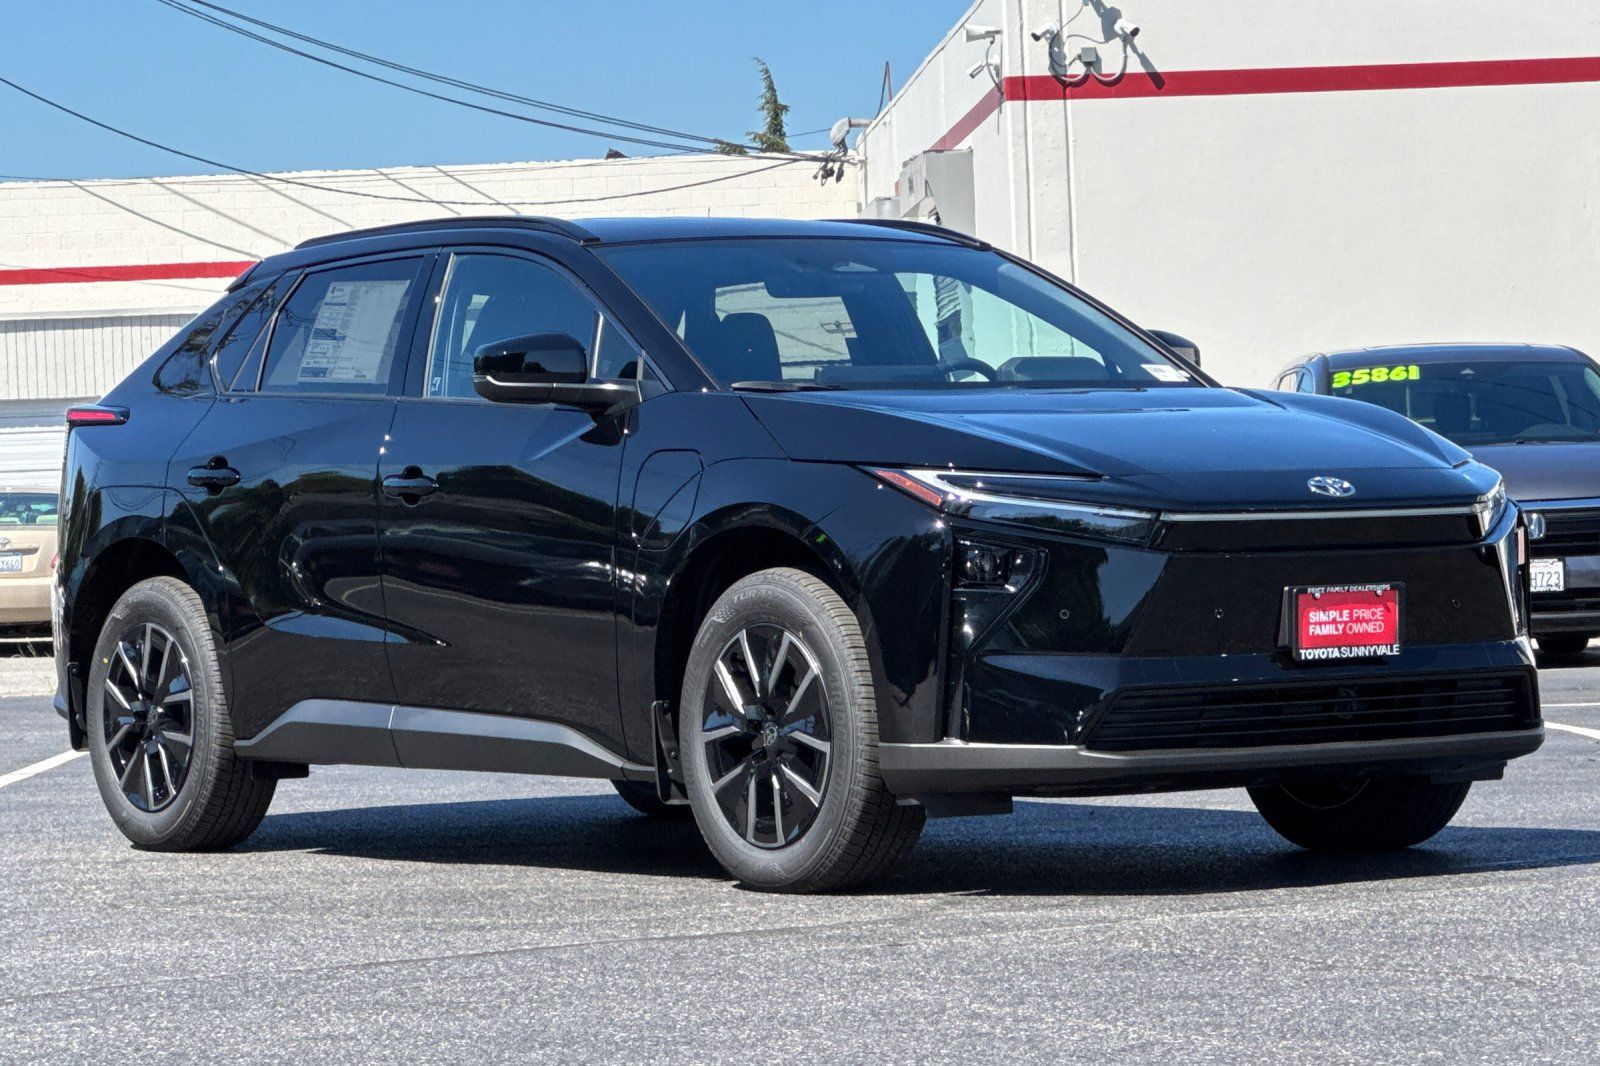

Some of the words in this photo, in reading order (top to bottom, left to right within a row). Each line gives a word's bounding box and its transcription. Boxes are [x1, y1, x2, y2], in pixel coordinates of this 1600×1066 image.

[1332, 365, 1420, 388] 35861
[1327, 585, 1349, 593] FAMILY
[1309, 610, 1350, 623] SIMPLE
[1353, 608, 1384, 620] PRICE
[1309, 623, 1344, 636] FAMILY
[1347, 621, 1384, 634] OWNED
[1300, 647, 1340, 660] TOYOTA
[1341, 644, 1400, 658] SUNNYVALE
